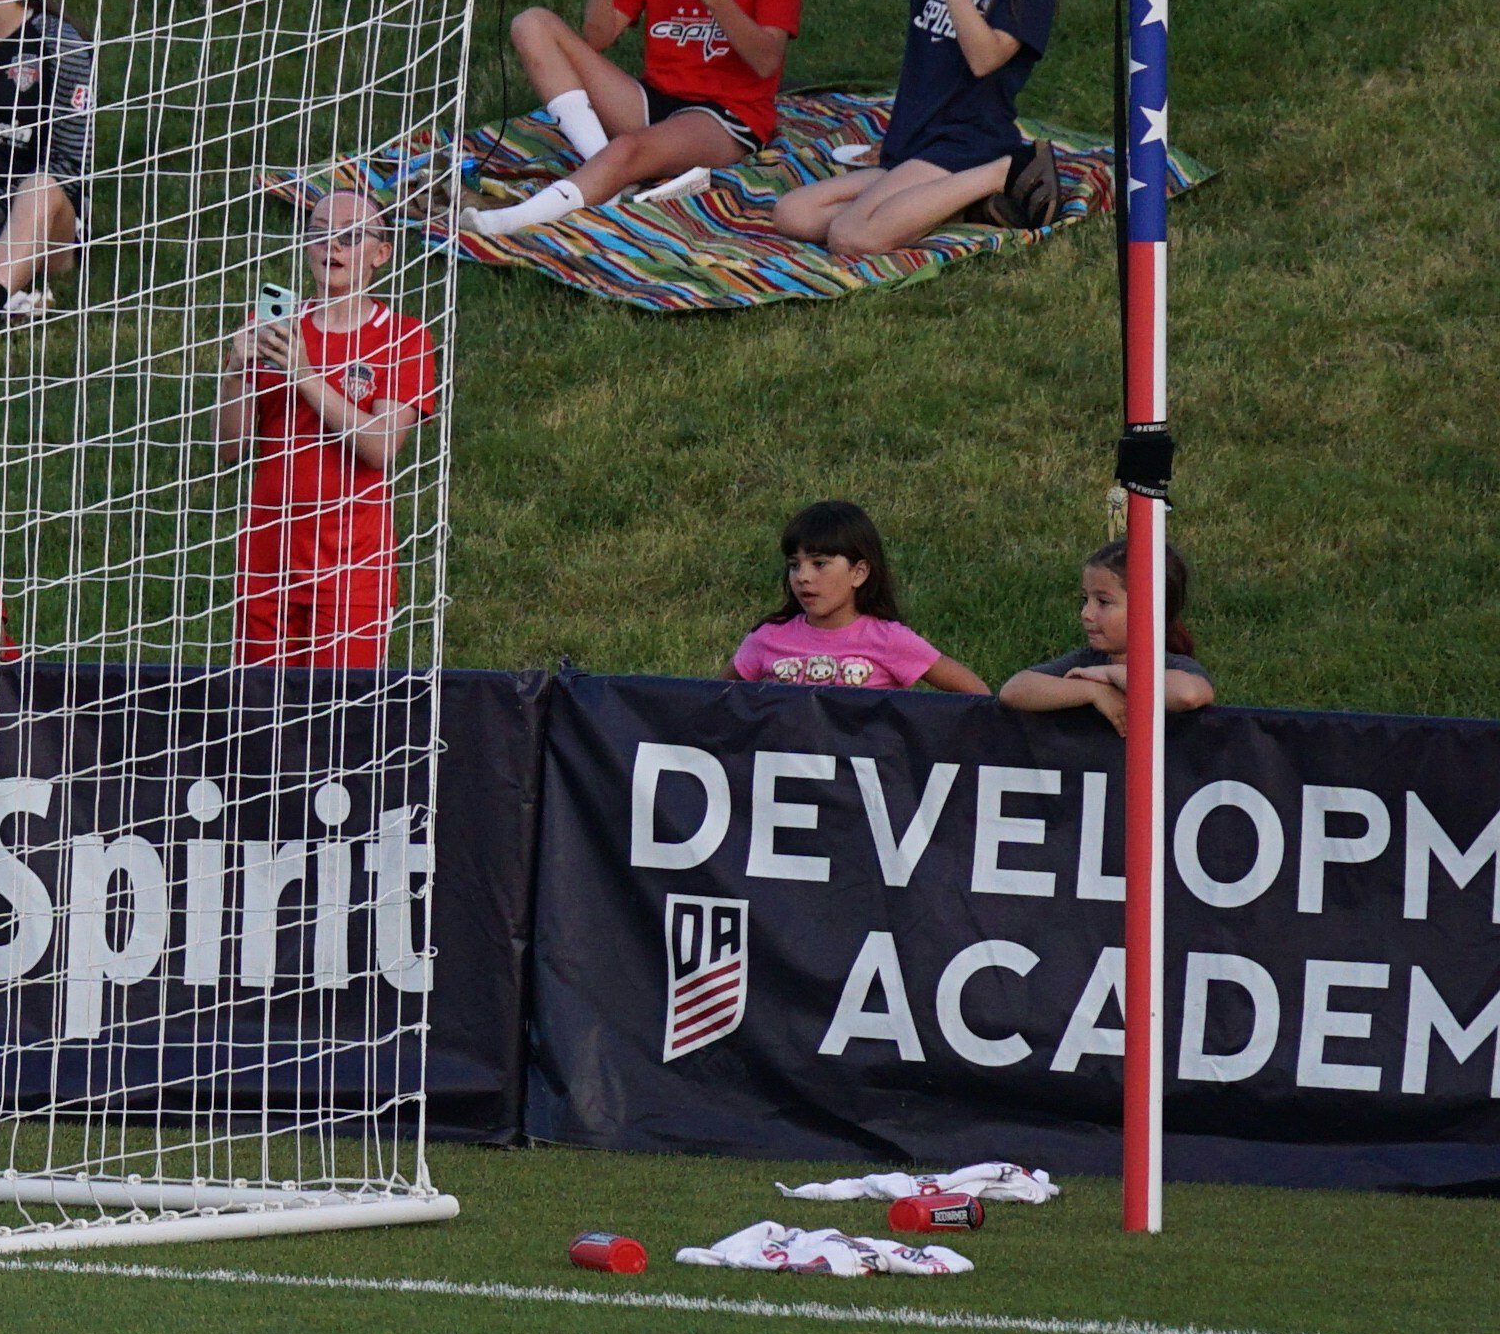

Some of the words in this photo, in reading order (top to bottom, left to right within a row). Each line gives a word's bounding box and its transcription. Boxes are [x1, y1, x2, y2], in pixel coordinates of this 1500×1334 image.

[650, 20, 730, 61] capita
[630, 742, 1500, 923] DEVELOPM
[673, 903, 742, 976] DA
[818, 931, 1500, 1098] ACADEM
